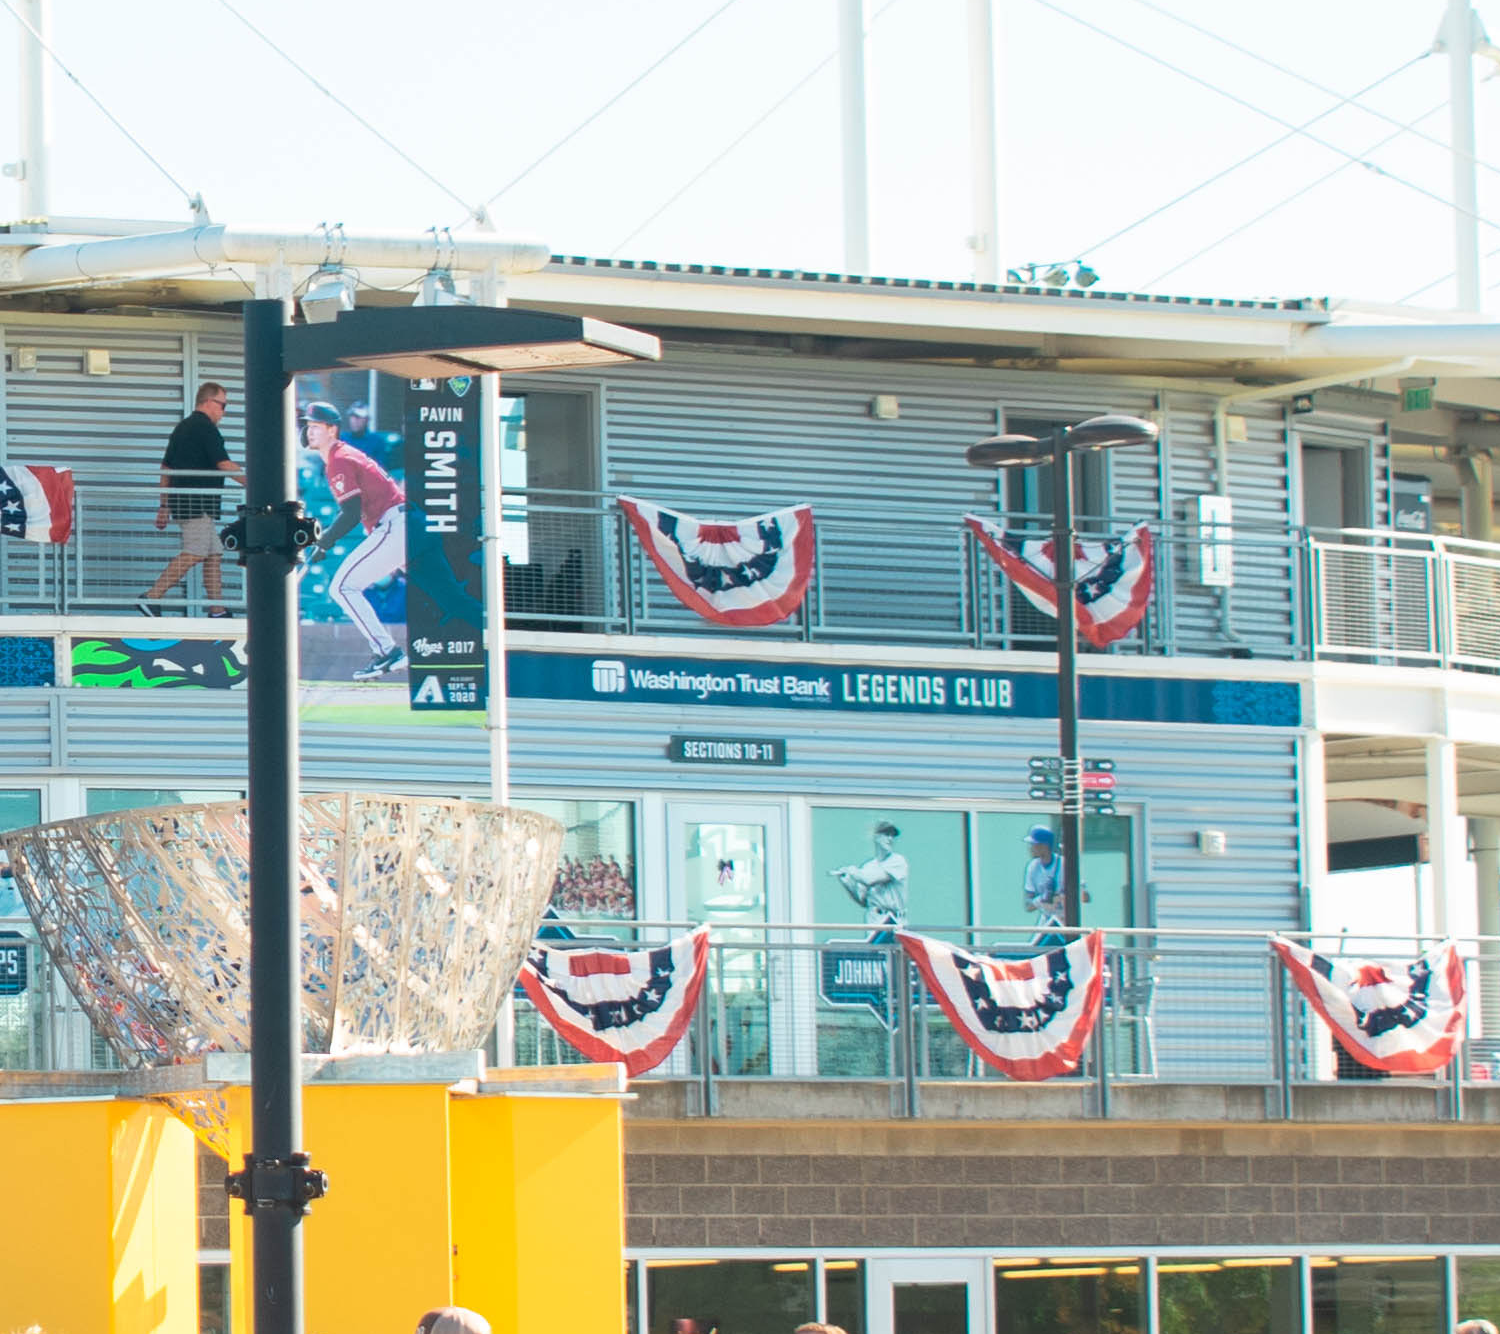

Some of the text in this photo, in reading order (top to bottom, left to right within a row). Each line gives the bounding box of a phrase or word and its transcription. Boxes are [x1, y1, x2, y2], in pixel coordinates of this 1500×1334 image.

[420, 406, 463, 423] PAVIN
[424, 430, 458, 534] SMITH
[412, 636, 477, 657] Hops 2017
[629, 668, 830, 699] Washington Trust Bank
[841, 672, 1013, 709] LEGENDS CLUB
[449, 691, 477, 703] 2020
[683, 740, 774, 761] SECTIONS 10-11
